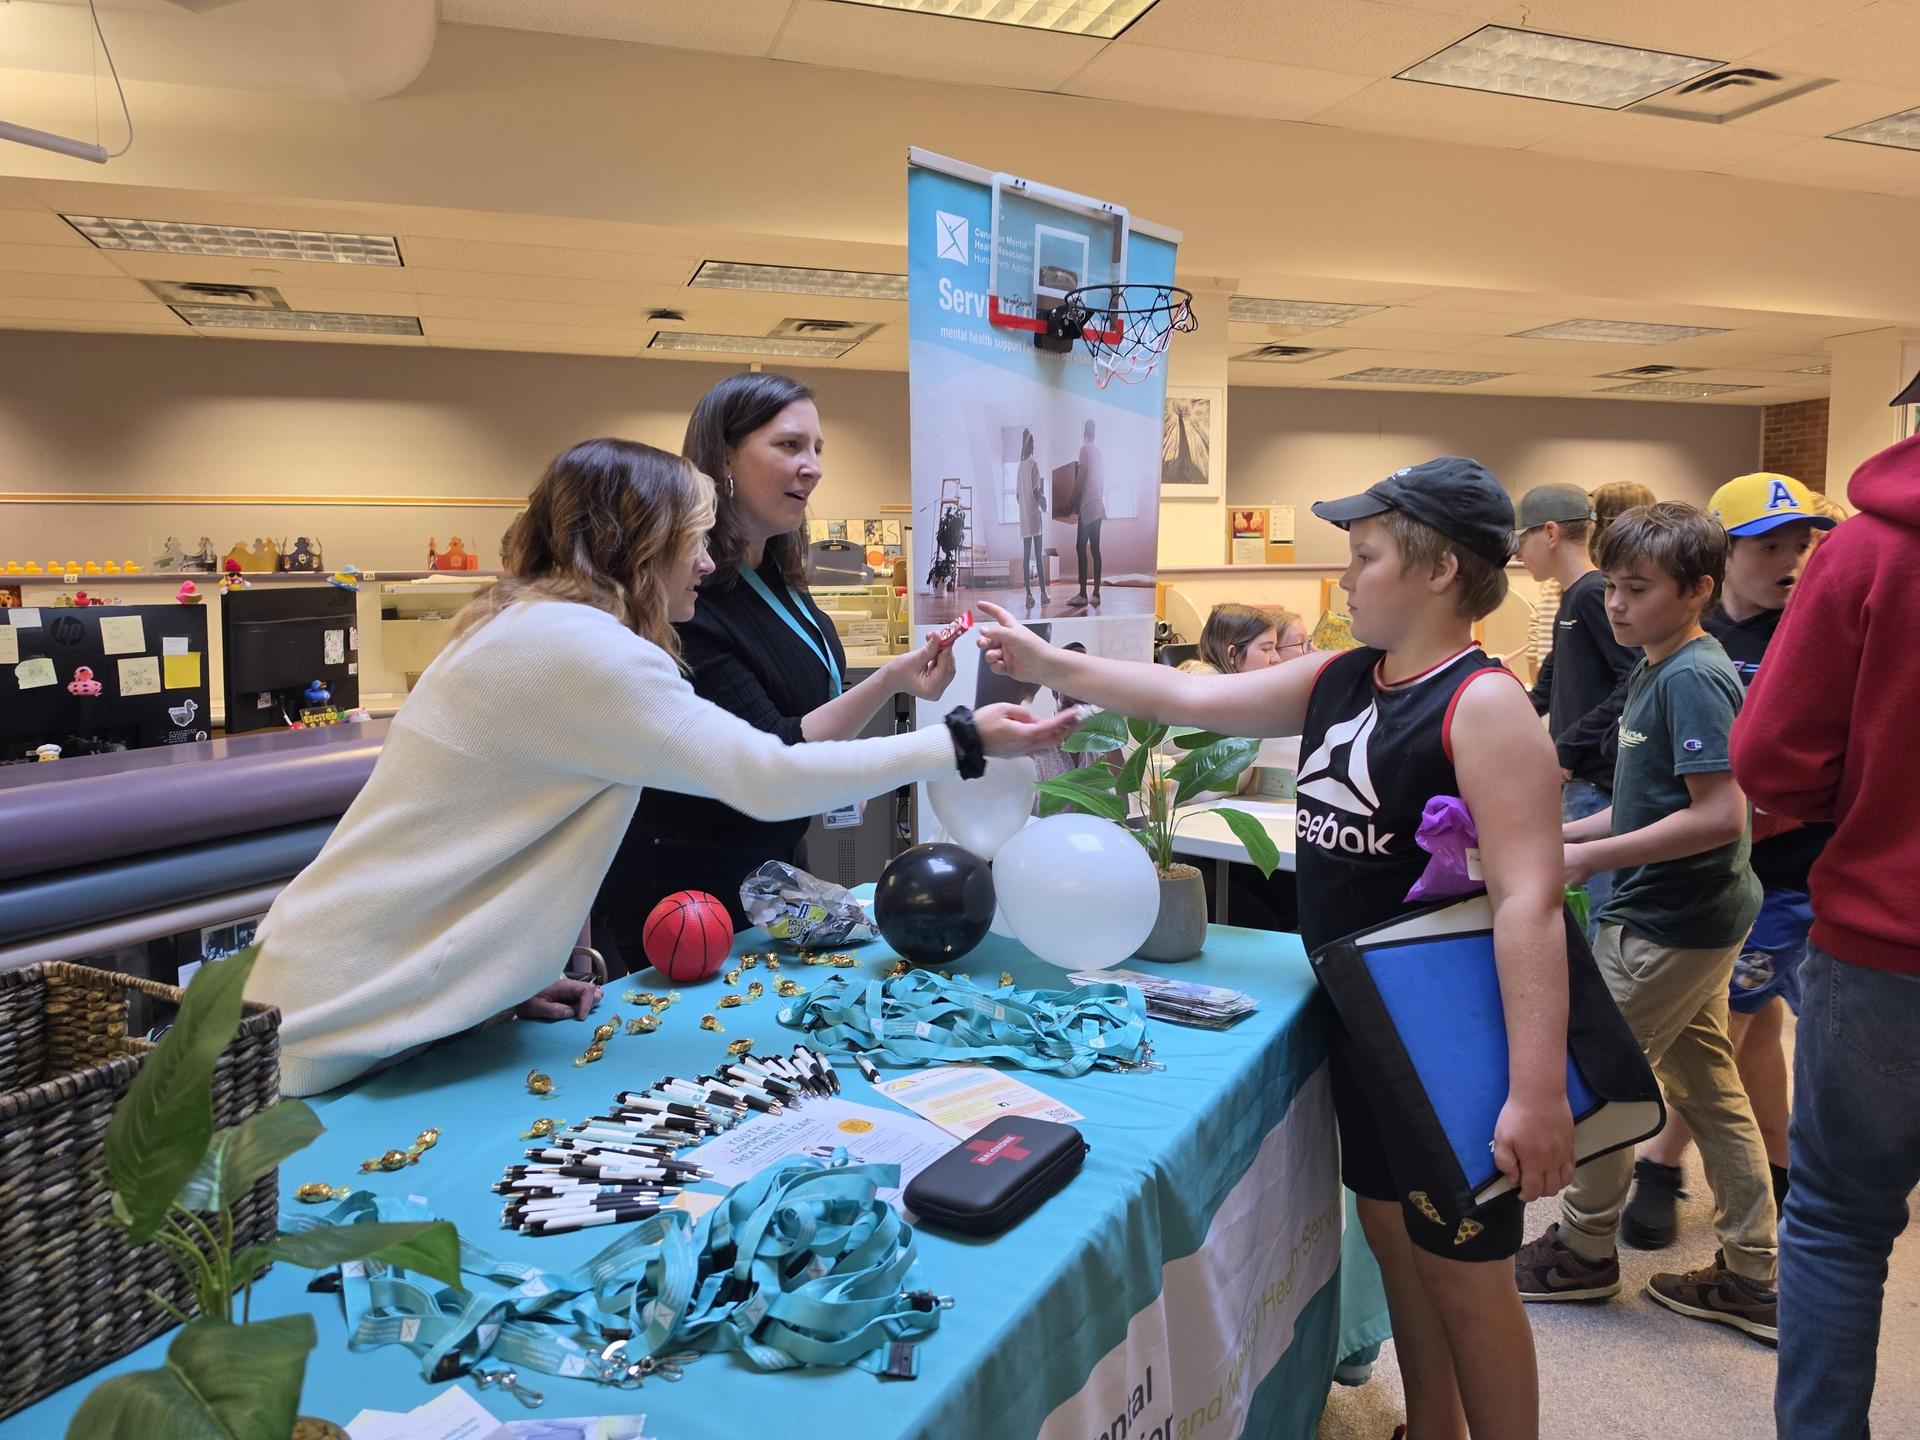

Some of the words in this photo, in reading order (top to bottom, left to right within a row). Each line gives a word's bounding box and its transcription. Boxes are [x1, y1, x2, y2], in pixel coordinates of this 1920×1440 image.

[974, 254, 990, 265] Huro
[940, 327, 968, 339] mental
[970, 330, 993, 347] health
[994, 338, 1022, 354] support
[1765, 480, 1799, 511] A
[1296, 808, 1396, 856] eebok
[728, 1125, 765, 1146] YOUTH
[728, 1133, 789, 1166] TREATMENT
[785, 1117, 816, 1133] TEAM
[732, 1122, 787, 1154] COMMUNITY
[977, 1135, 1017, 1163] NALOXONE
[1176, 1386, 1223, 1440] and
